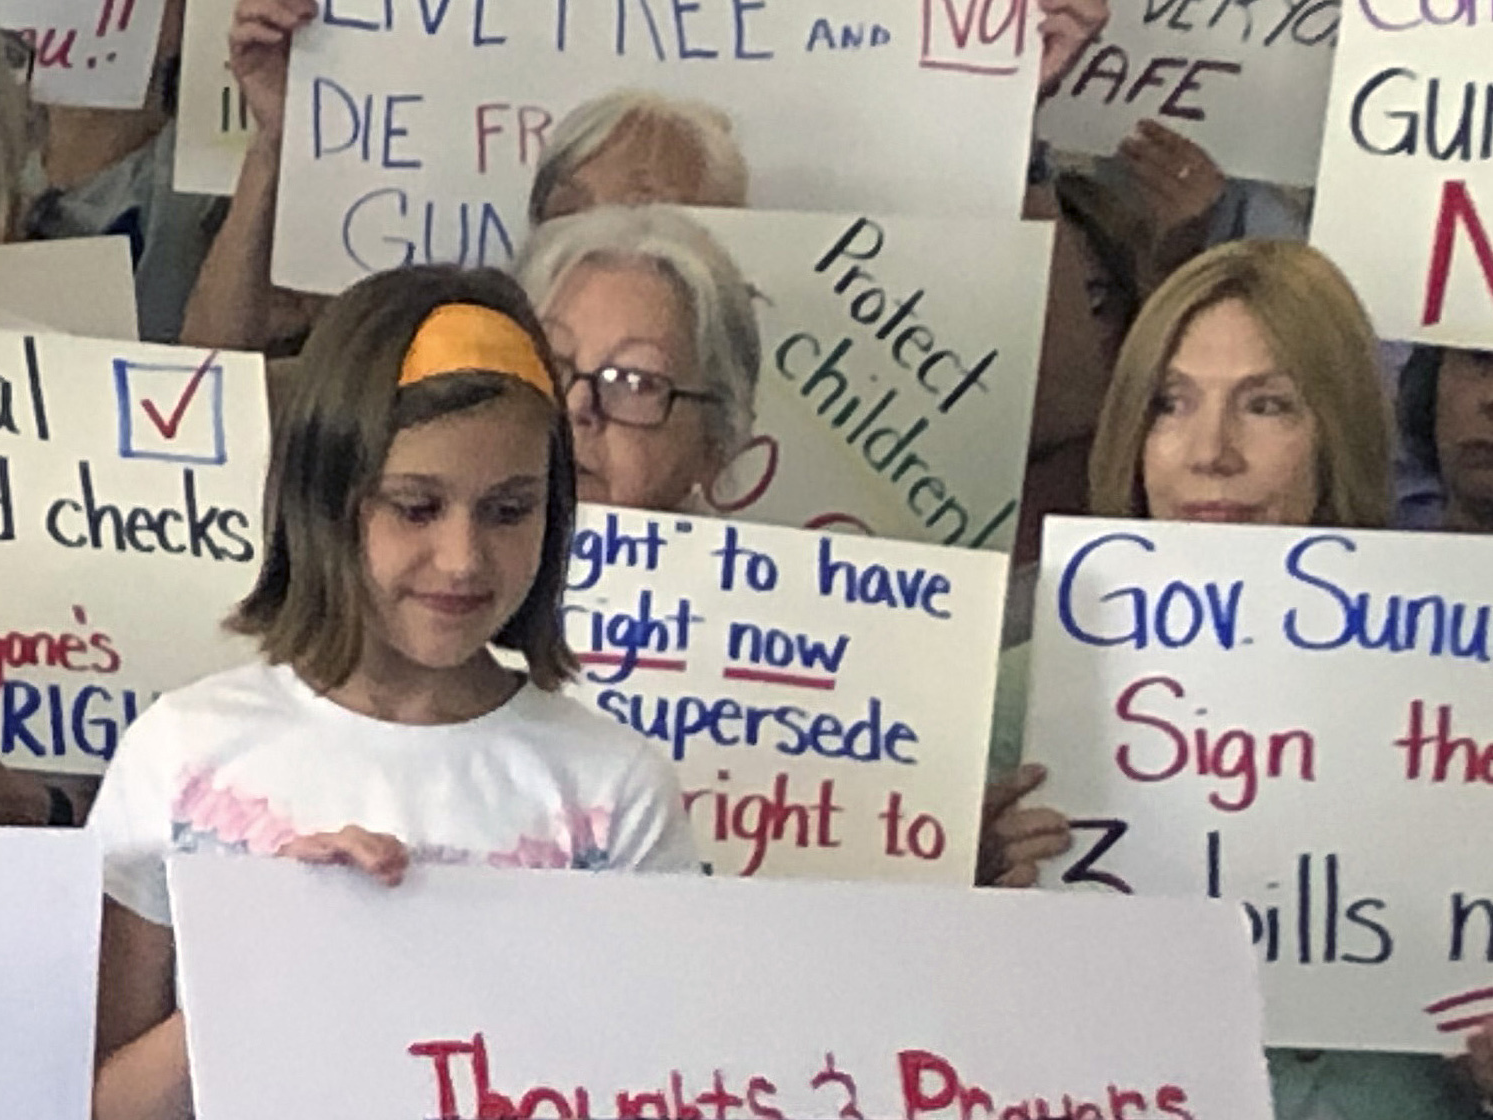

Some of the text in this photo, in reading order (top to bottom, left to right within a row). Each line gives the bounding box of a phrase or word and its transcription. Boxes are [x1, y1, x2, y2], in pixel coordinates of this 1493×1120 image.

[806, 18, 891, 52] AND
[313, 77, 424, 169] DIE
[1066, 43, 1242, 121] AFE
[813, 216, 999, 414] Protect
[46, 459, 255, 562] checks
[711, 526, 779, 591] to
[818, 536, 952, 619] have
[1057, 533, 1254, 650] Gov.
[727, 621, 851, 674] now
[596, 688, 919, 765] supersede
[1115, 676, 1317, 813] Sign
[877, 790, 947, 860] to
